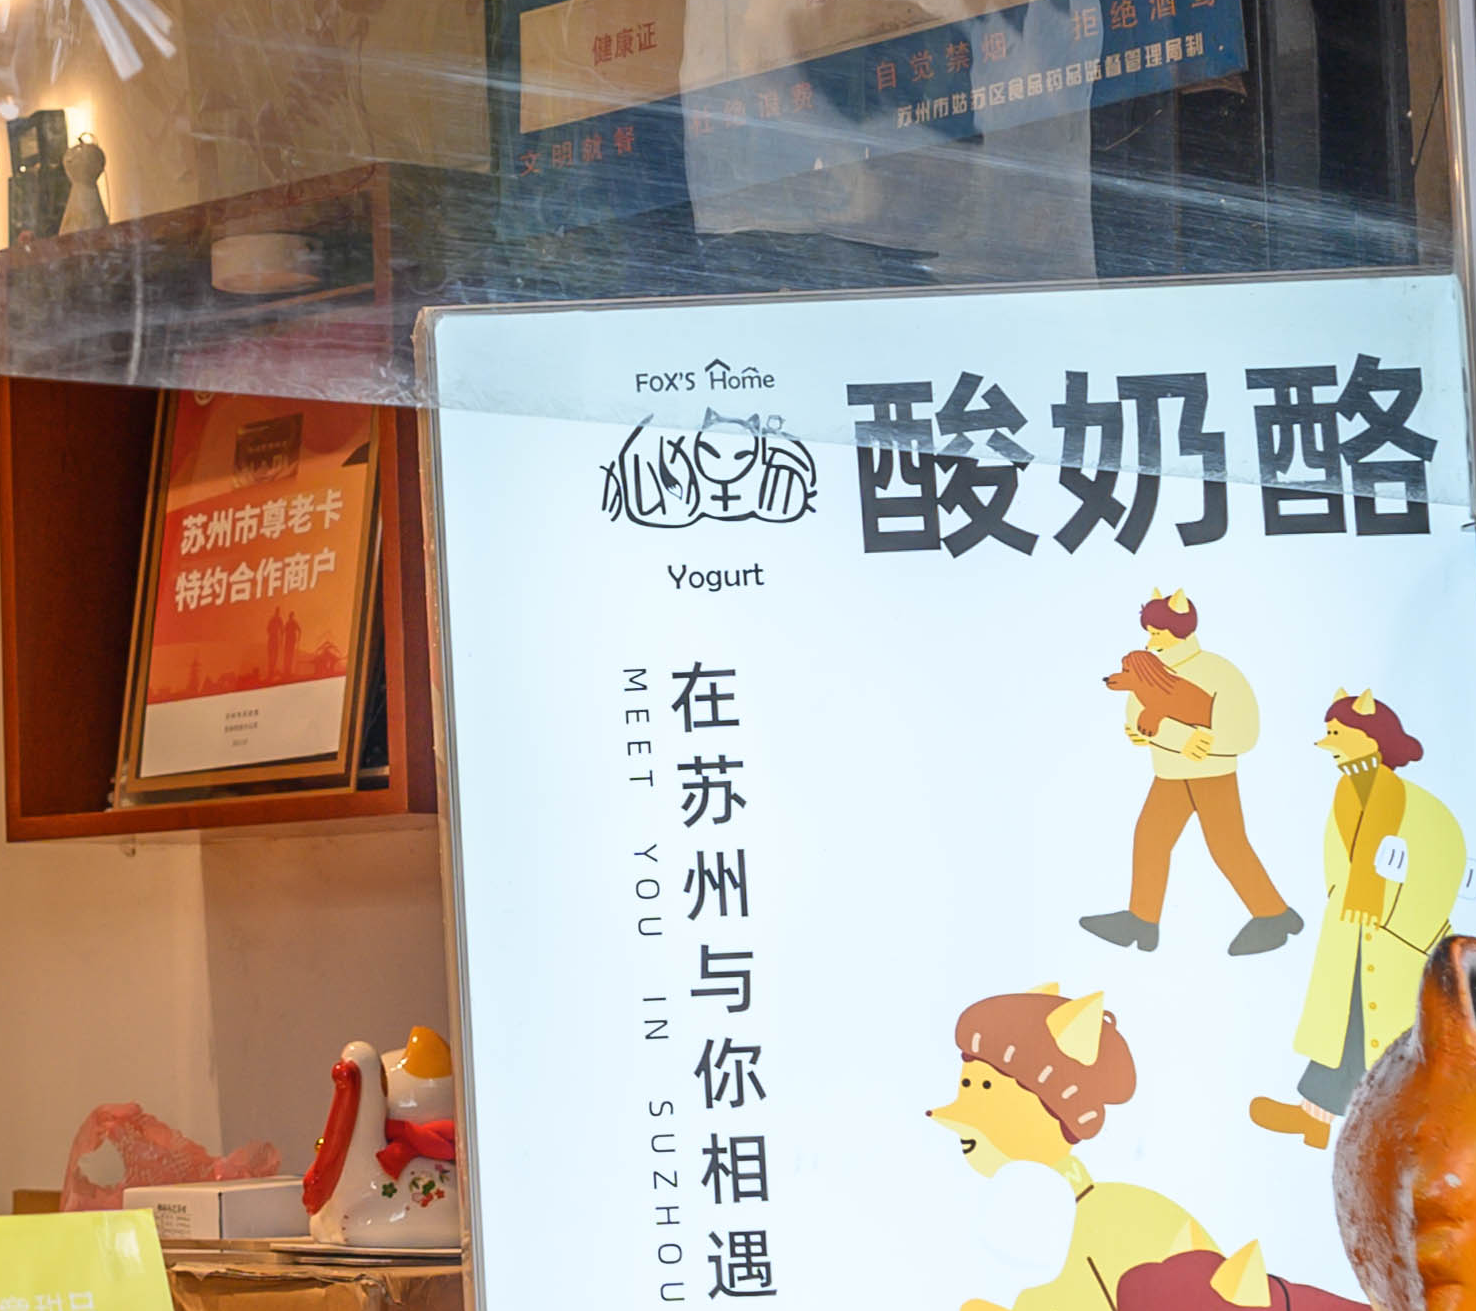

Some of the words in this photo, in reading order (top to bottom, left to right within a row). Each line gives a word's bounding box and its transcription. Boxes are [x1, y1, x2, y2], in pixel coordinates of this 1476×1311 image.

[591, 21, 658, 68] 健康证
[876, 32, 1007, 91] 自觉禁烟
[704, 358, 776, 391] Home
[846, 353, 1439, 559] 酸奶酪
[180, 488, 344, 556] 苏州市尊老卡
[174, 546, 336, 613] 特约合作商户
[667, 563, 765, 592] Yogurt
[623, 668, 654, 787] MEET
[633, 843, 663, 936] YOU
[670, 661, 778, 1300] 在苏州与你相遇
[642, 996, 670, 1040] IN
[648, 1100, 686, 1301] SUZHOU
